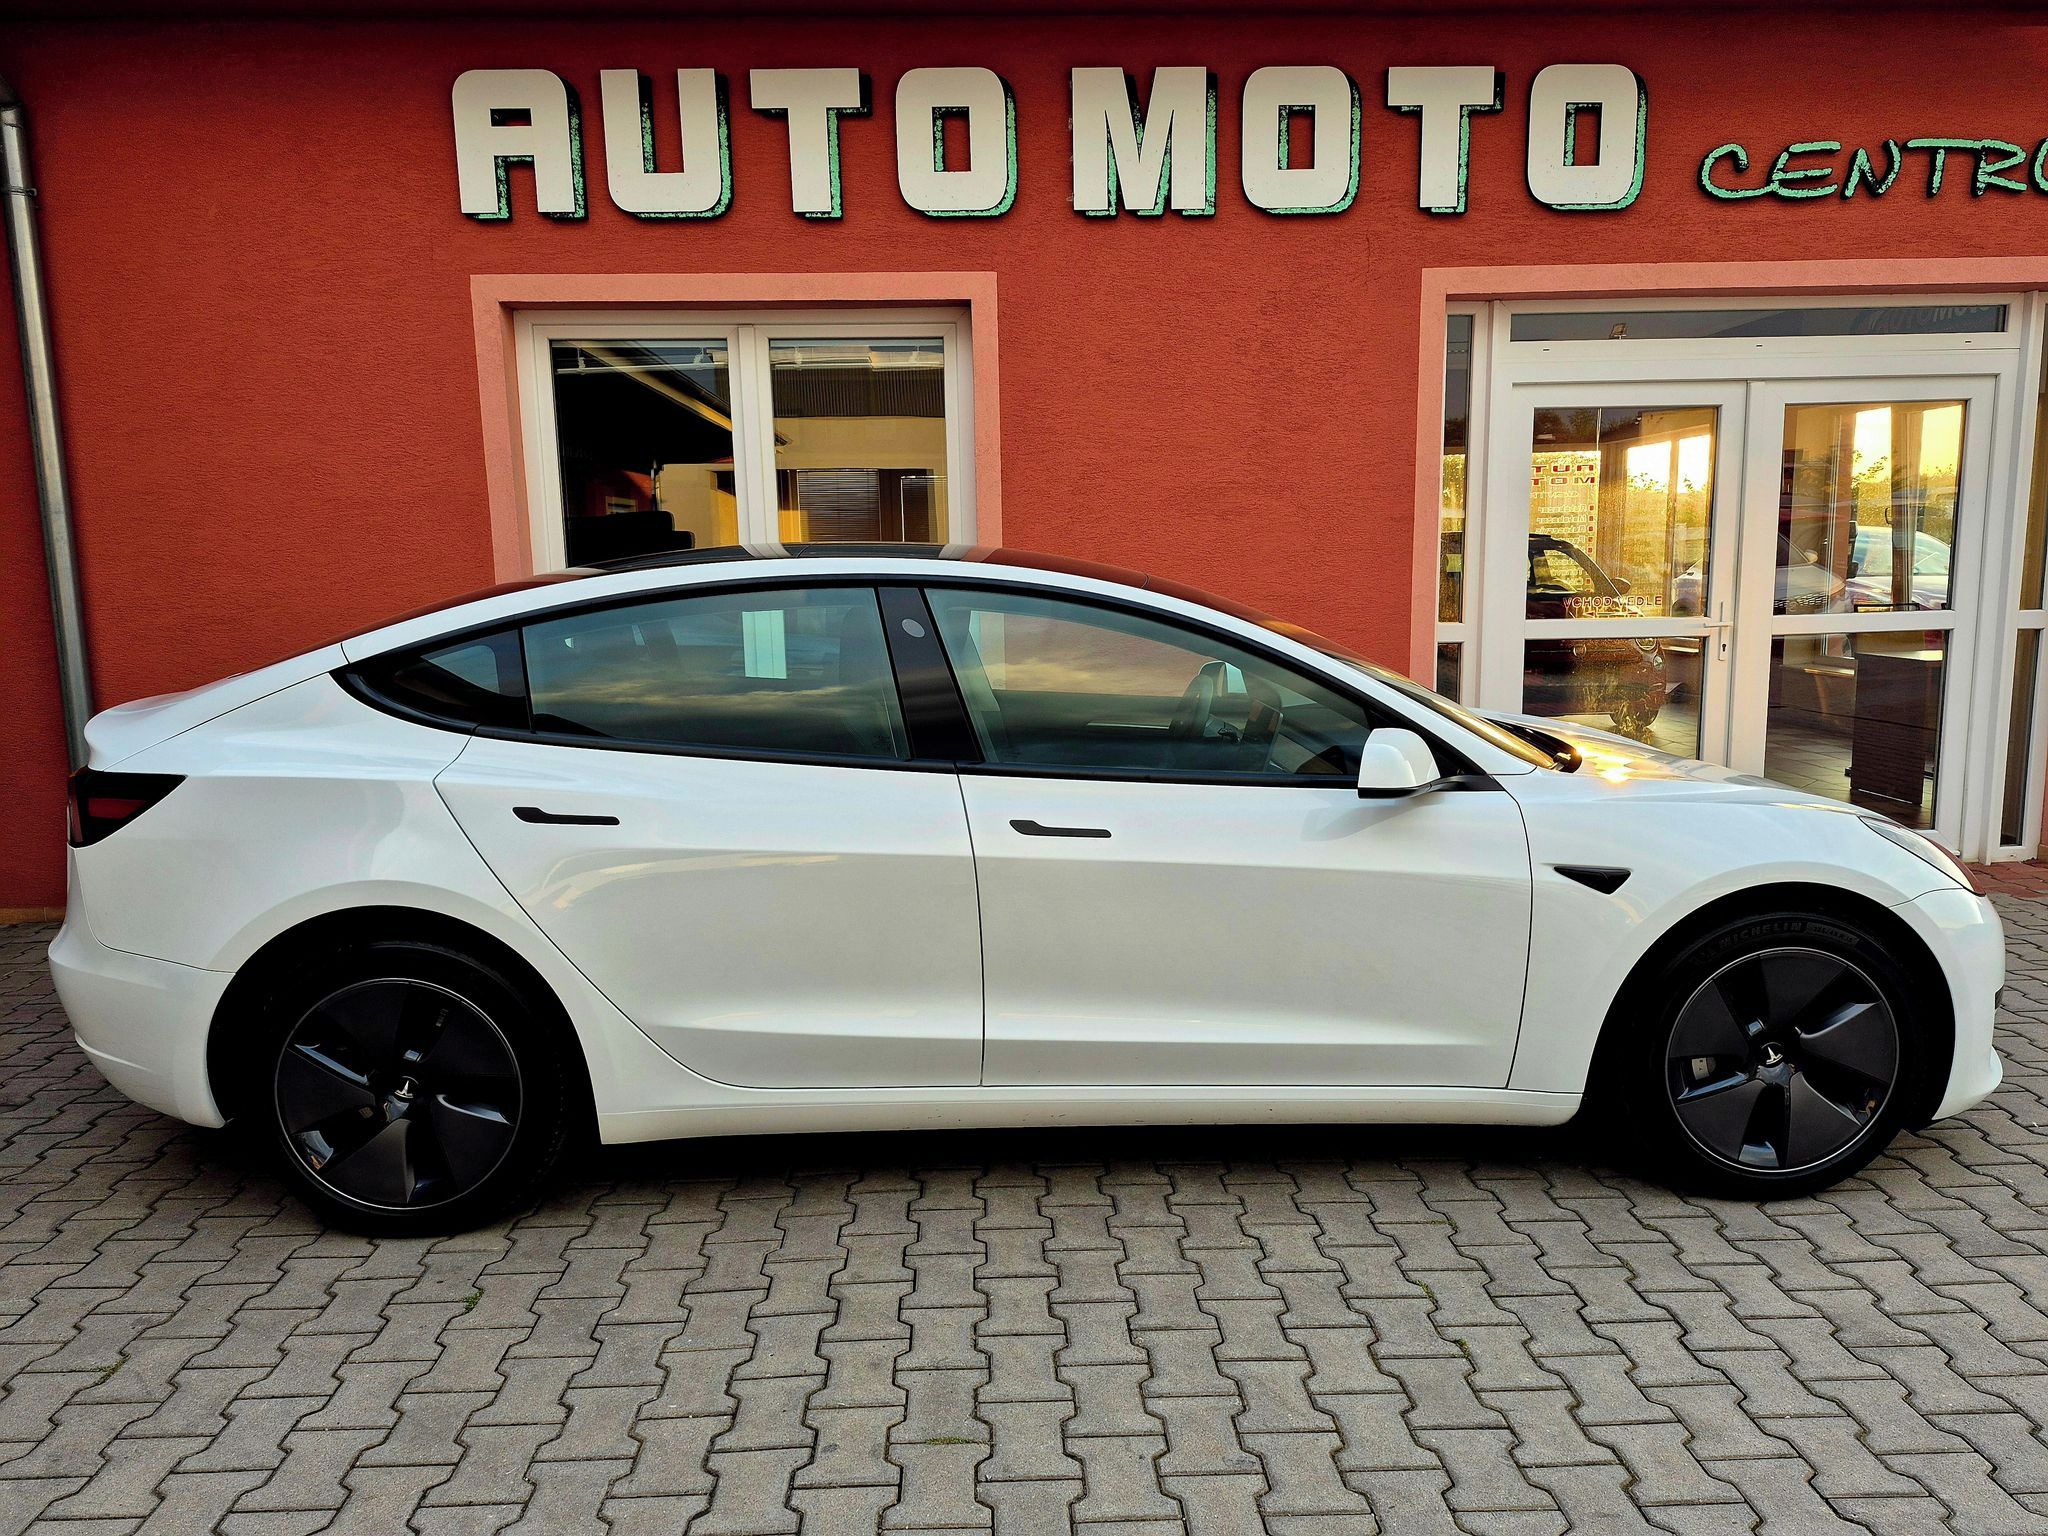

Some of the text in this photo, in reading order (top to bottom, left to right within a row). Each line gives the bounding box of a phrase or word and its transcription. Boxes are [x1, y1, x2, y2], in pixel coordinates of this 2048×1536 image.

[451, 63, 1648, 220] AUTO MOTO
[1563, 595, 1663, 609] VCHOD VEDLE
[1719, 922, 1802, 949] MICHELIN
